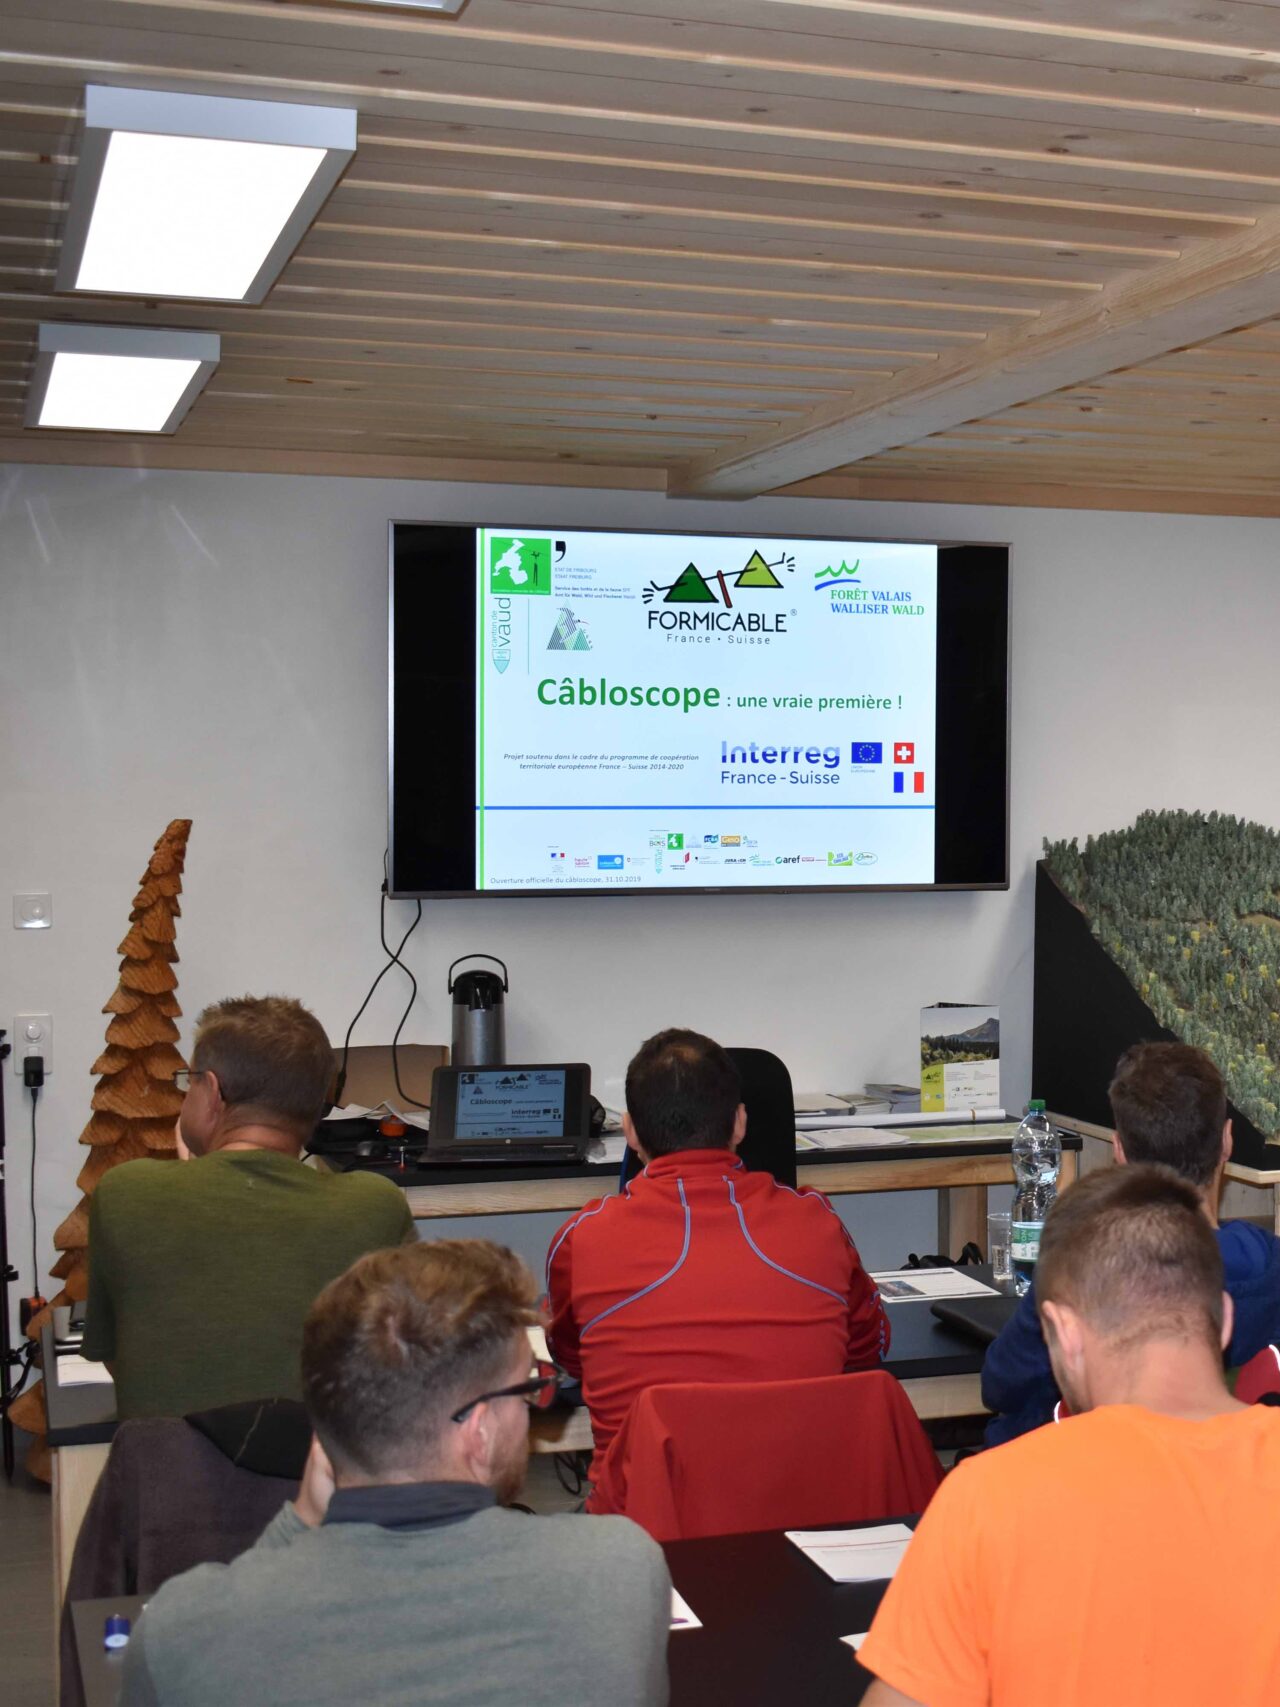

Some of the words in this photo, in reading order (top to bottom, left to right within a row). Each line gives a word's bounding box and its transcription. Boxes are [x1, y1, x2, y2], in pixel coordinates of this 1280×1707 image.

[830, 588, 868, 601] FORÊT
[871, 590, 912, 602] VALAIS
[830, 602, 889, 615] WALLISER
[891, 604, 925, 616] WALD
[494, 597, 512, 648] vaud
[648, 610, 788, 633] FORMICABLE
[666, 633, 711, 644] France
[727, 635, 771, 645] Suisse
[536, 677, 721, 713] Câbloscope
[736, 694, 768, 708] une
[773, 692, 813, 709] vraie
[818, 693, 893, 713] première
[503, 753, 524, 762] Projet
[525, 753, 553, 761] soutenu
[554, 753, 571, 761] dans
[572, 753, 578, 761] le
[579, 753, 598, 761] cadre
[599, 753, 609, 762] du
[610, 754, 649, 763] programme
[650, 753, 659, 762] de
[659, 753, 700, 763] coopération
[720, 740, 841, 769] Interreg
[519, 762, 557, 770] territoriale
[557, 762, 597, 771] européenne
[649, 763, 685, 771] 2014-2020
[720, 770, 777, 785] France
[788, 770, 841, 785] Suisse
[490, 876, 524, 884] Ouverture
[525, 876, 554, 884] officielle
[555, 876, 564, 884] du
[605, 876, 642, 884] 31.10.2019
